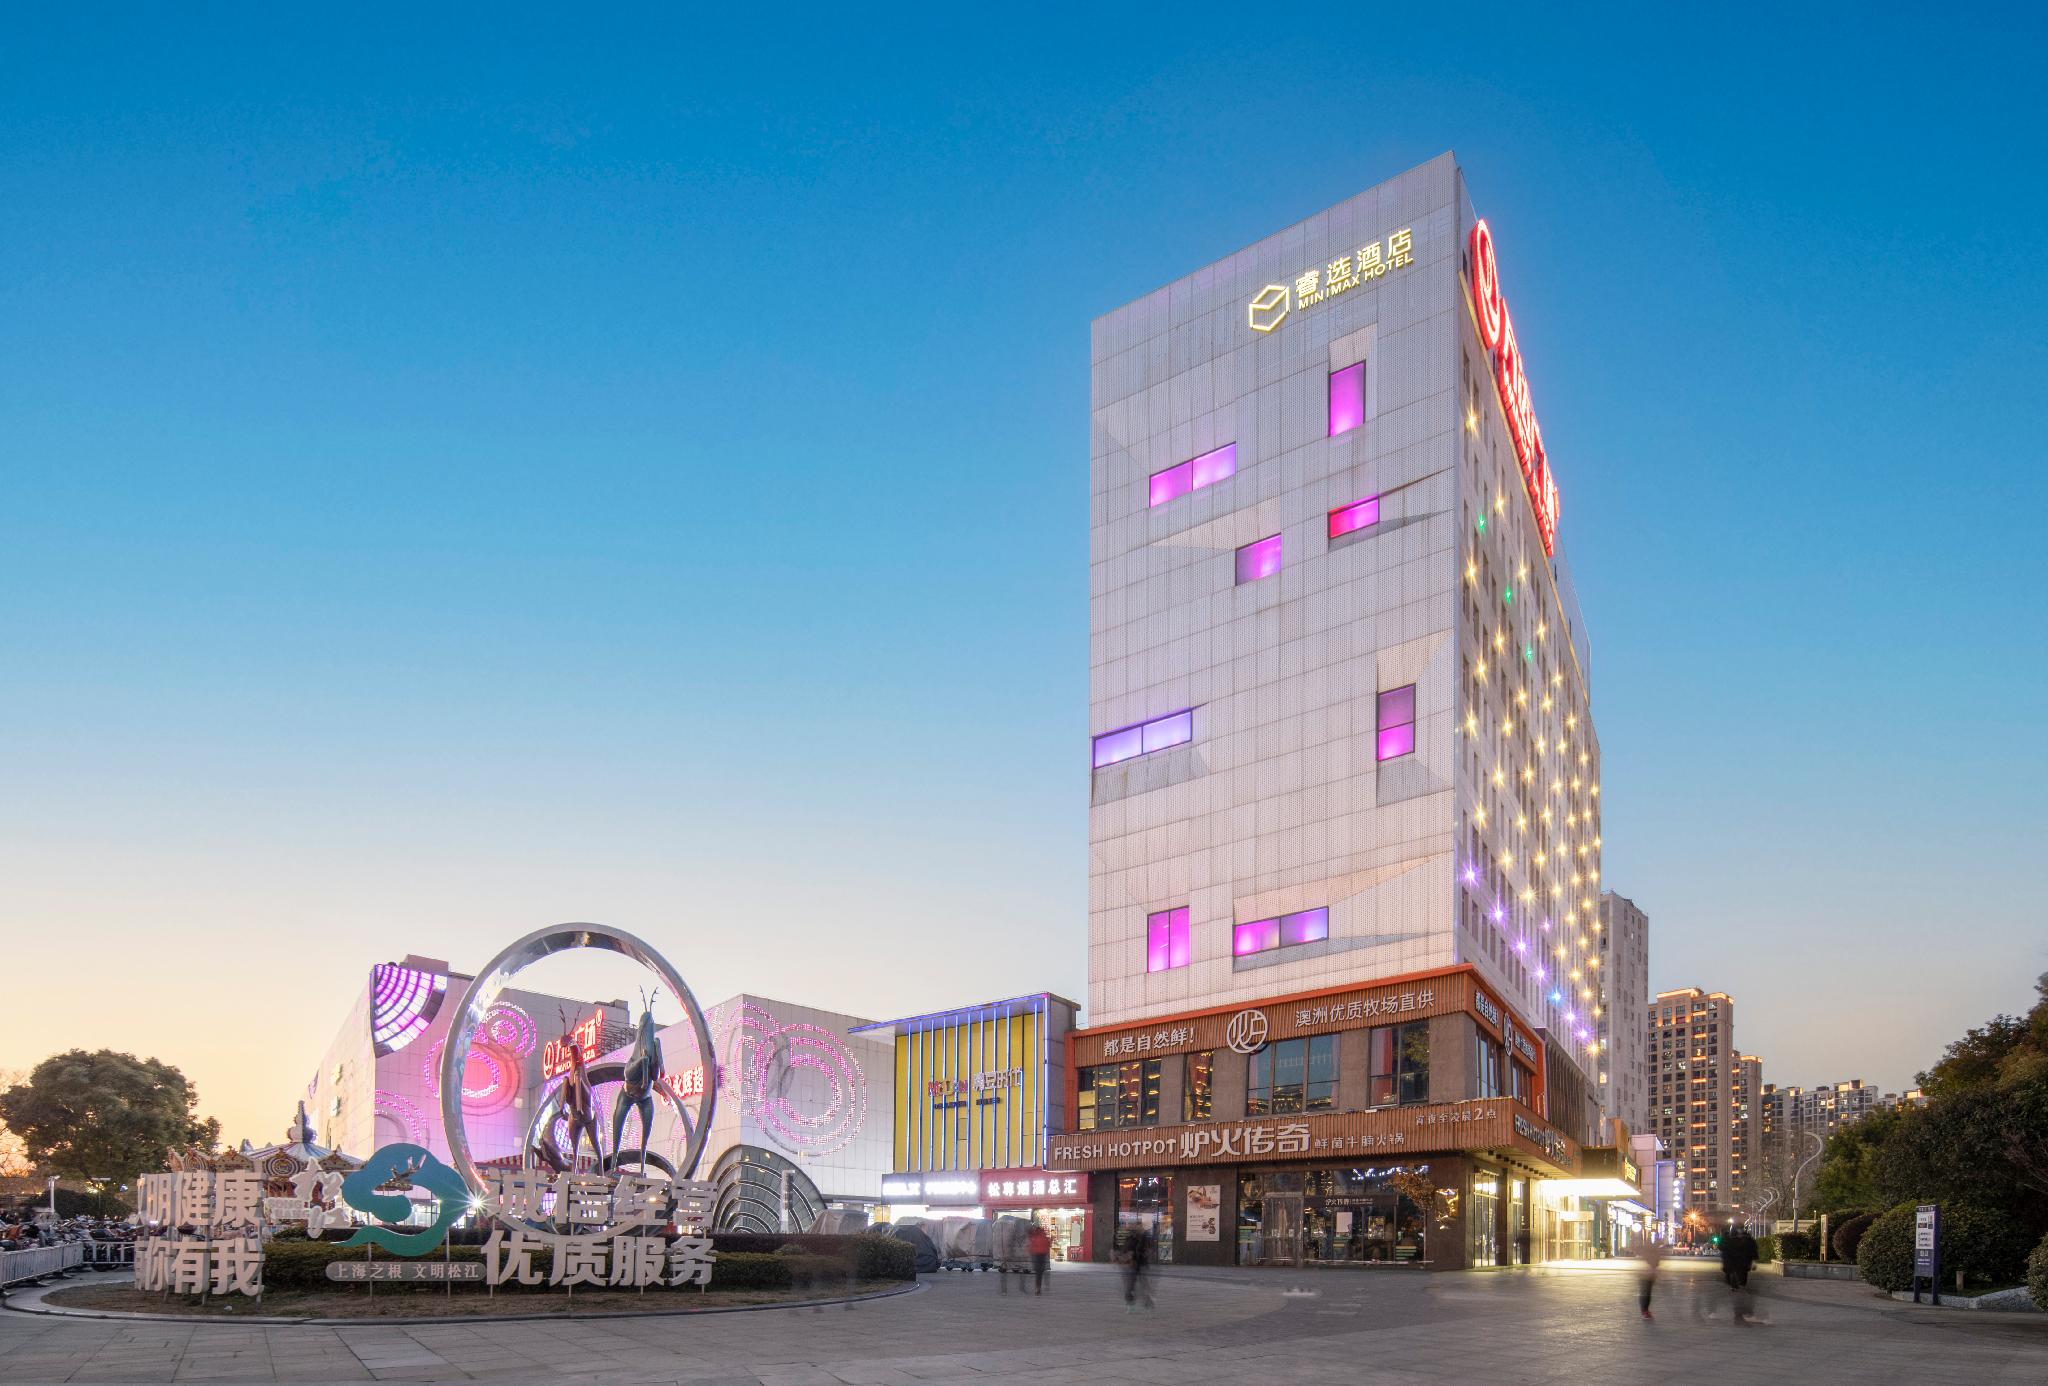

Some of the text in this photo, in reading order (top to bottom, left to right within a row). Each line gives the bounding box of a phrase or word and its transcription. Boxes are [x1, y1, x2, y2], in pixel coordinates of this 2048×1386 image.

[1296, 228, 1412, 298] 睿选酒店
[1298, 252, 1414, 310] MINIMAX HOTEL
[1294, 988, 1436, 1028] 澳洲优质牧场直供
[1103, 1027, 1194, 1057] 都是自然鲜!
[1054, 1123, 1405, 1162] FRESH HOTPOT 炉火传奇 鲜菌牛腩火锅
[483, 1167, 719, 1228] 诚信经营
[334, 1263, 479, 1279] 上海之根 文明松江
[480, 1230, 718, 1287] 优质服务
